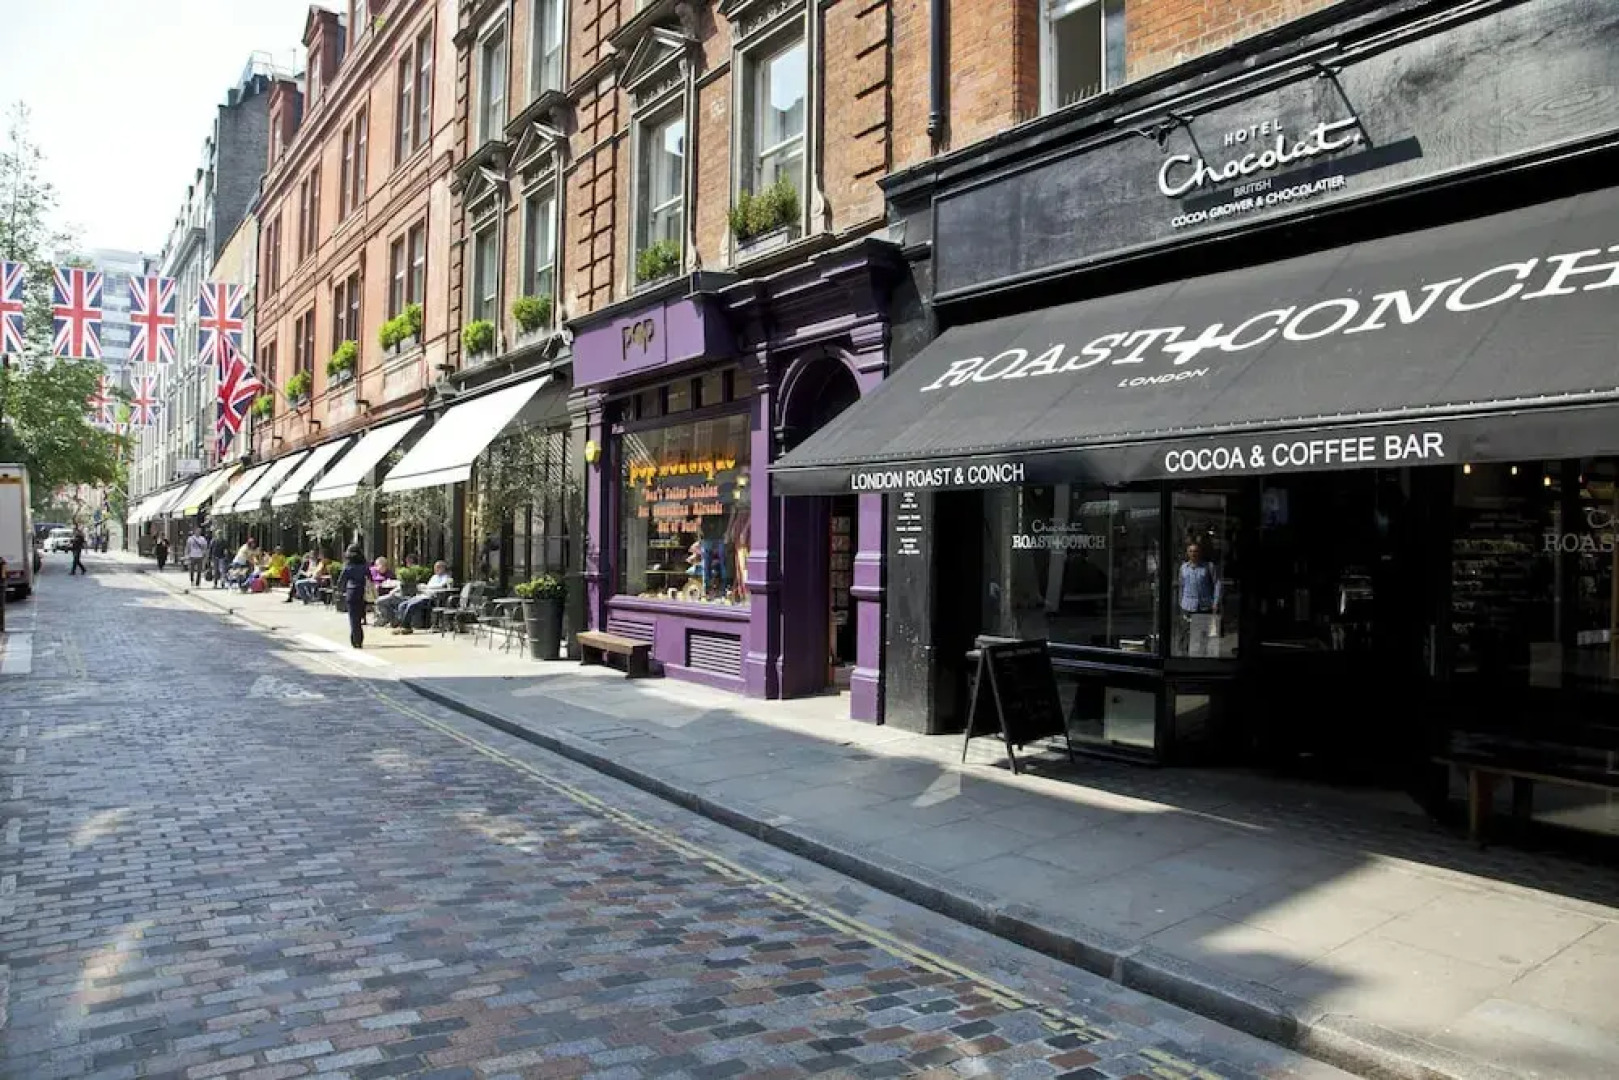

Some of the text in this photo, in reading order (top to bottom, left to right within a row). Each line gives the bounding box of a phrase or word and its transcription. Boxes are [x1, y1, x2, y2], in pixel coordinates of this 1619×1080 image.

[1224, 118, 1284, 146] HOTEL
[1171, 174, 1346, 228] COCOA GROWER & CHOCOLATIER
[1233, 178, 1272, 198] BRITISH
[1118, 367, 1210, 387] LONDON
[1164, 432, 1446, 472] COCOA & COFFEE BAR
[851, 462, 1025, 490] LONDON ROAST & CONCH
